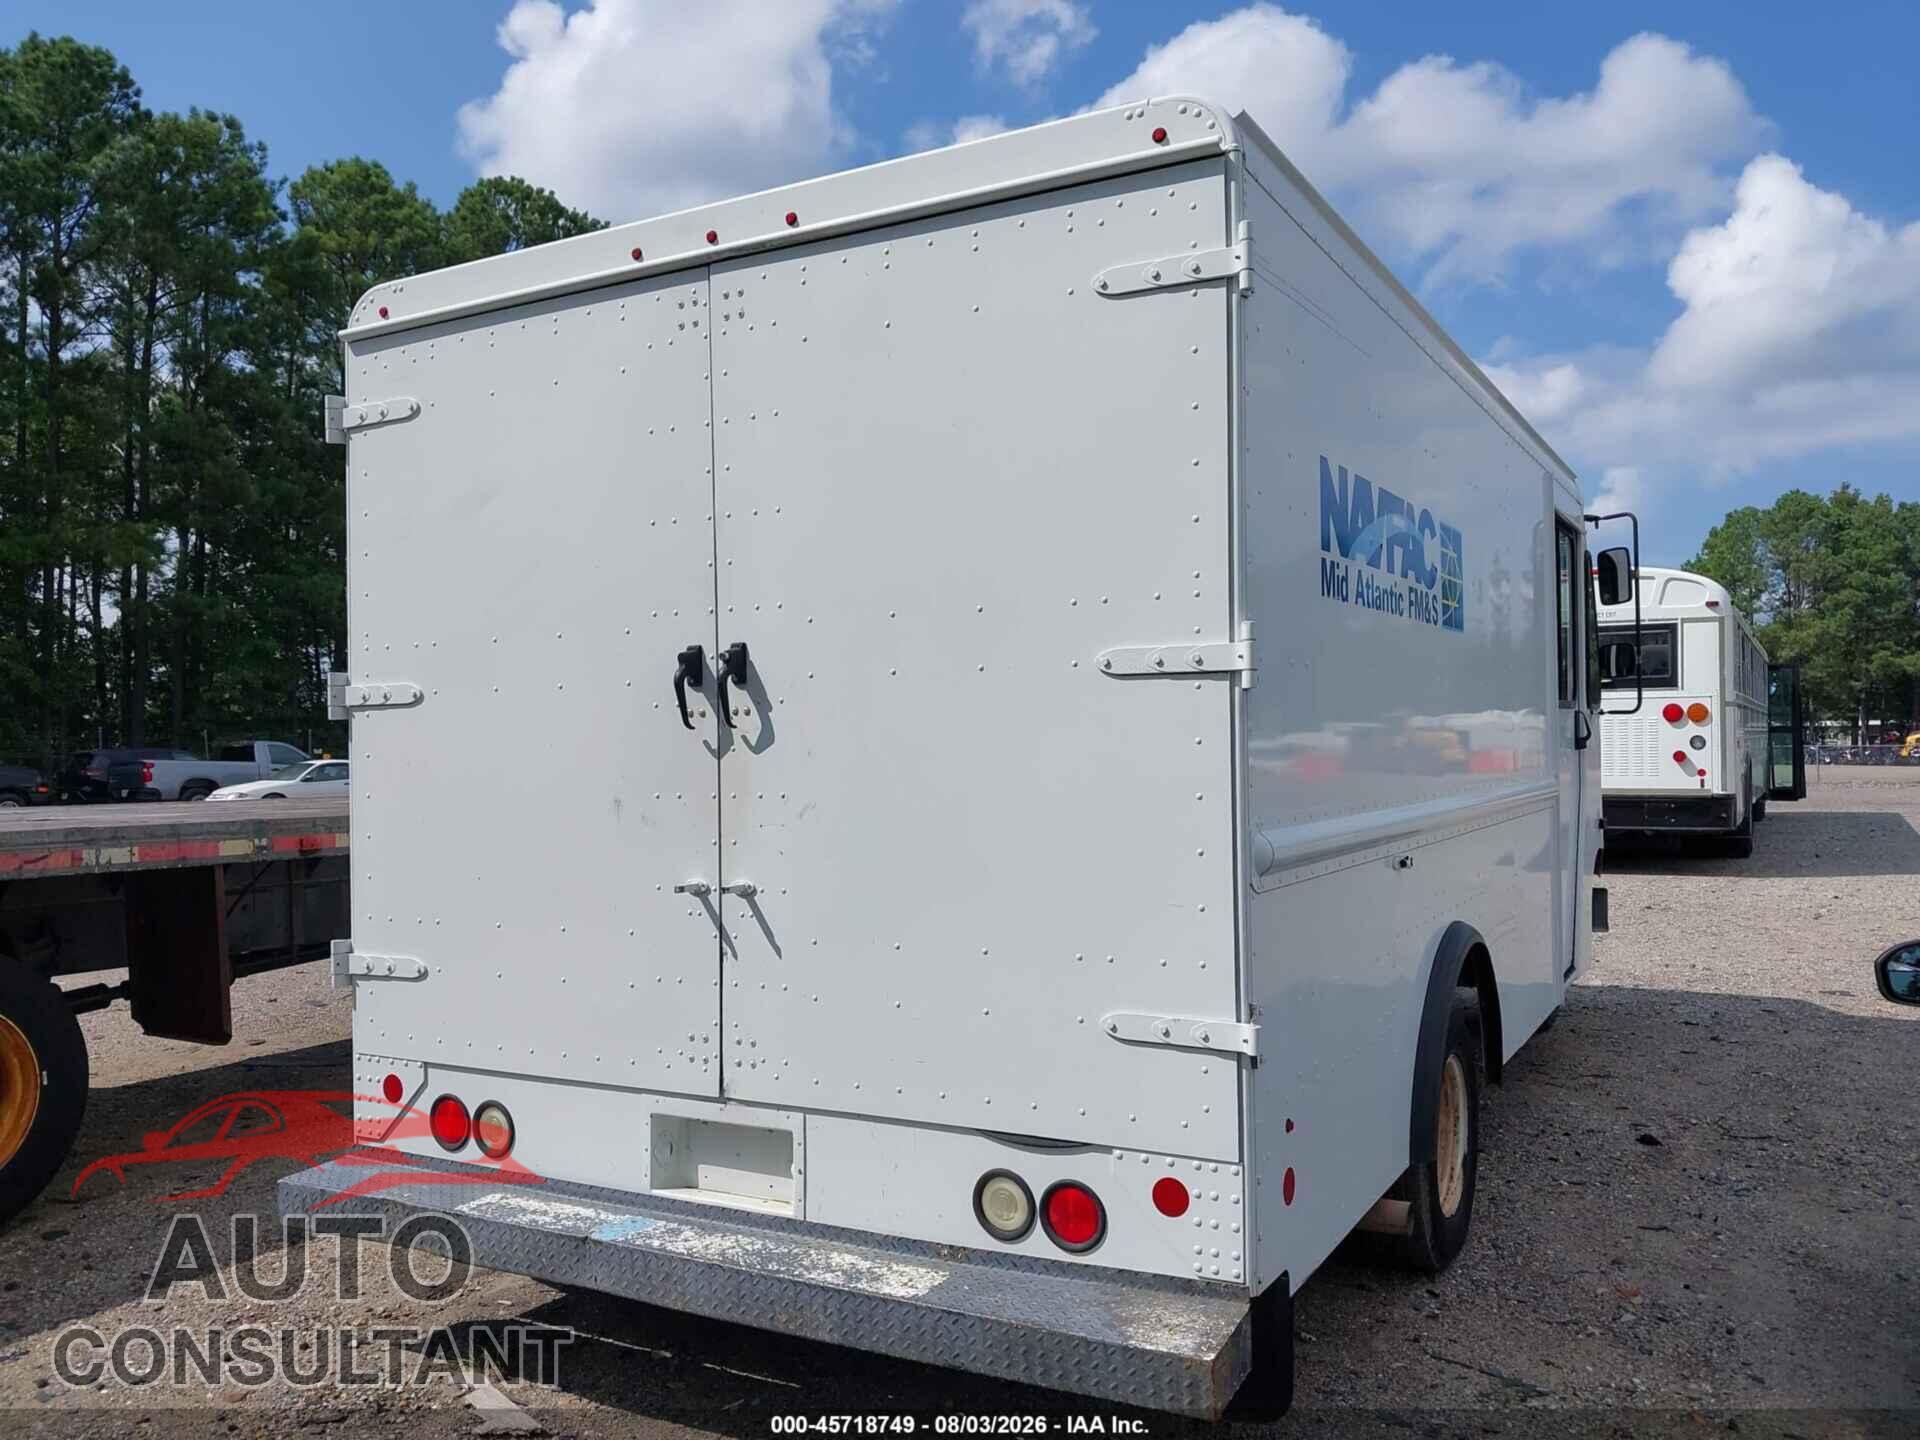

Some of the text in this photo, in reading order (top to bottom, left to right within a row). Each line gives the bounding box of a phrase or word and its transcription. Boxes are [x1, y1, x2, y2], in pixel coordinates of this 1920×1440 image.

[1321, 557, 1439, 626] Mid Atlantic FM&S
